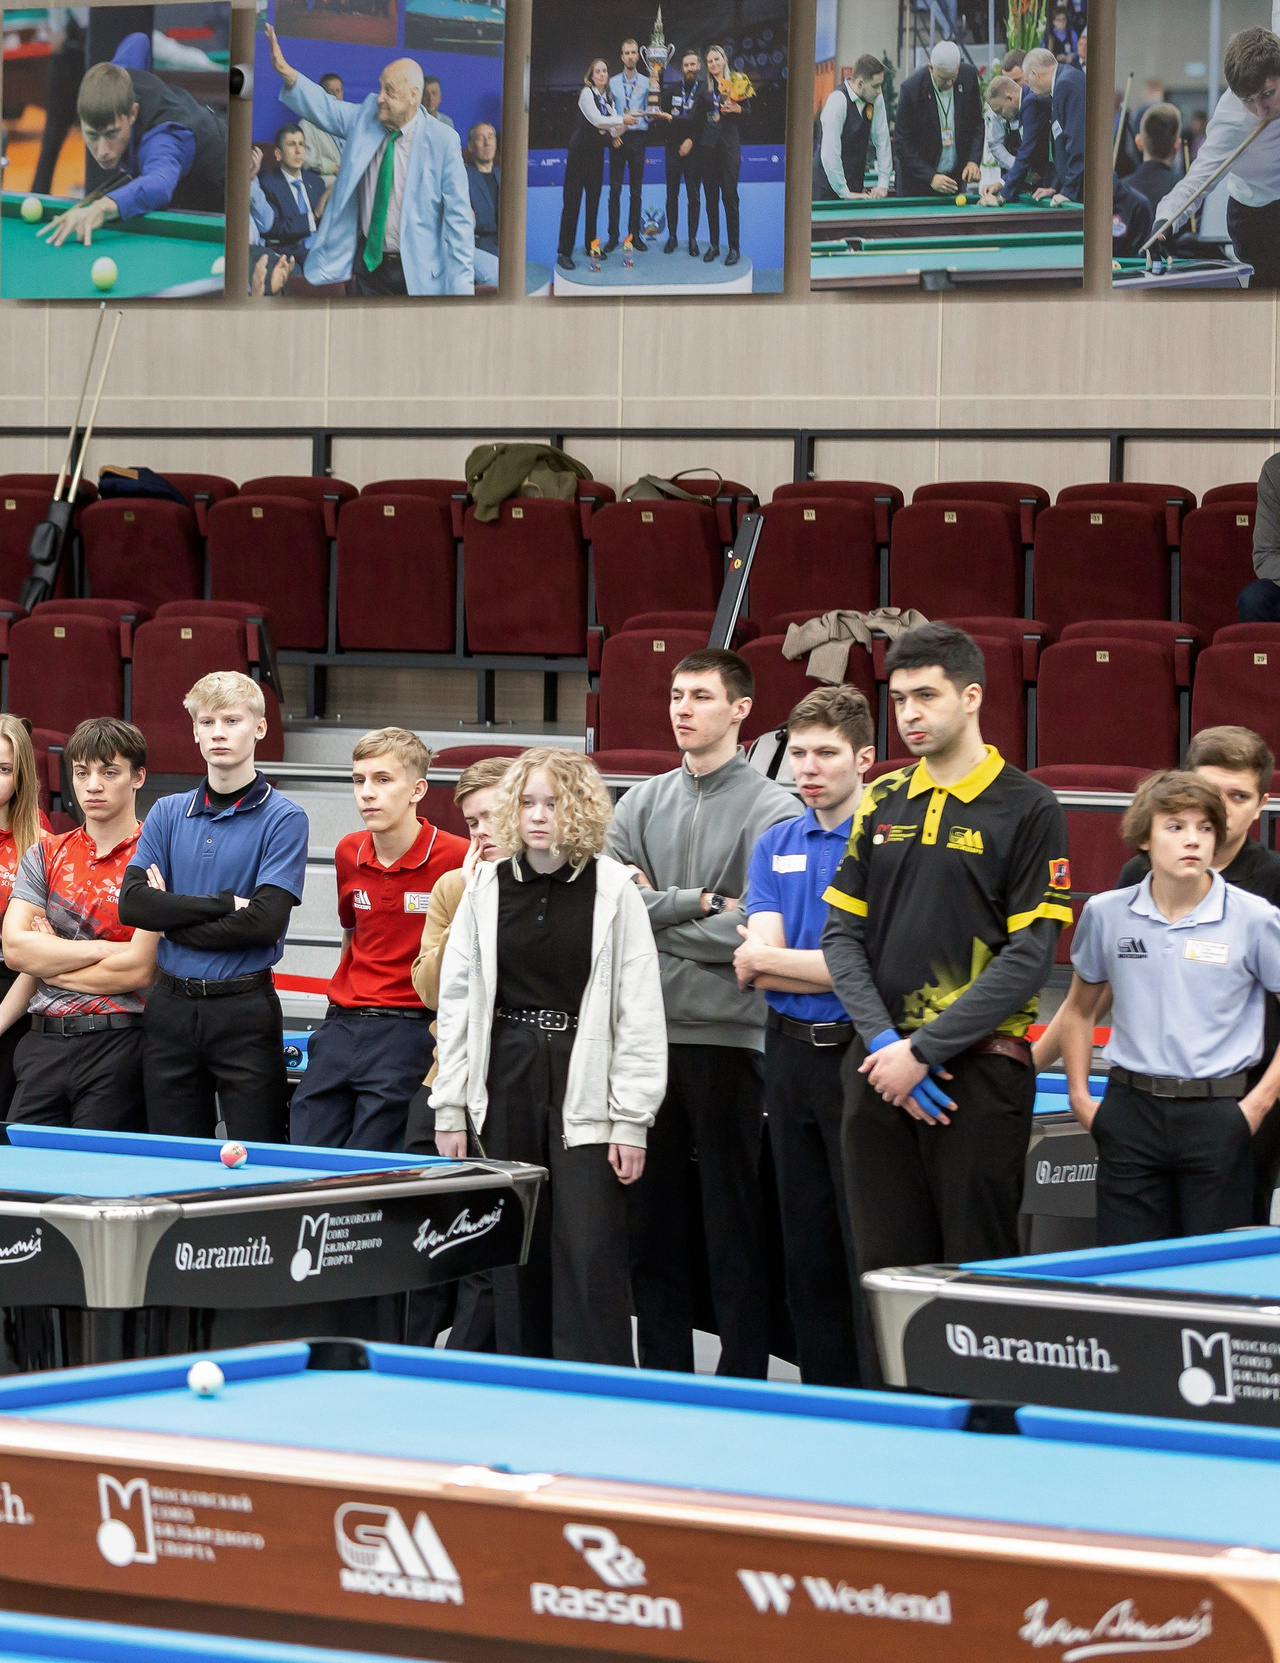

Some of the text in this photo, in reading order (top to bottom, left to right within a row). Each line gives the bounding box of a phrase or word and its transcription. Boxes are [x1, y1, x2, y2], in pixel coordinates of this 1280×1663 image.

[1051, 1157, 1099, 1184] arami
[329, 1209, 383, 1226] МОСКОВСКИЙ
[326, 1228, 350, 1240] СОЮЗ
[195, 1236, 271, 1269] aramith
[324, 1238, 382, 1253] БИЛЬЯРДНОГО
[322, 1254, 354, 1267] СПОРТА
[982, 1335, 1111, 1372] aramith
[1231, 1339, 1280, 1354] МОСКО
[1232, 1369, 1280, 1385] БИЛЬЯ
[1233, 1384, 1280, 1401] СПОРТ
[339, 1567, 464, 1605] МОСКВИЧ
[801, 1576, 952, 1624] Weekend
